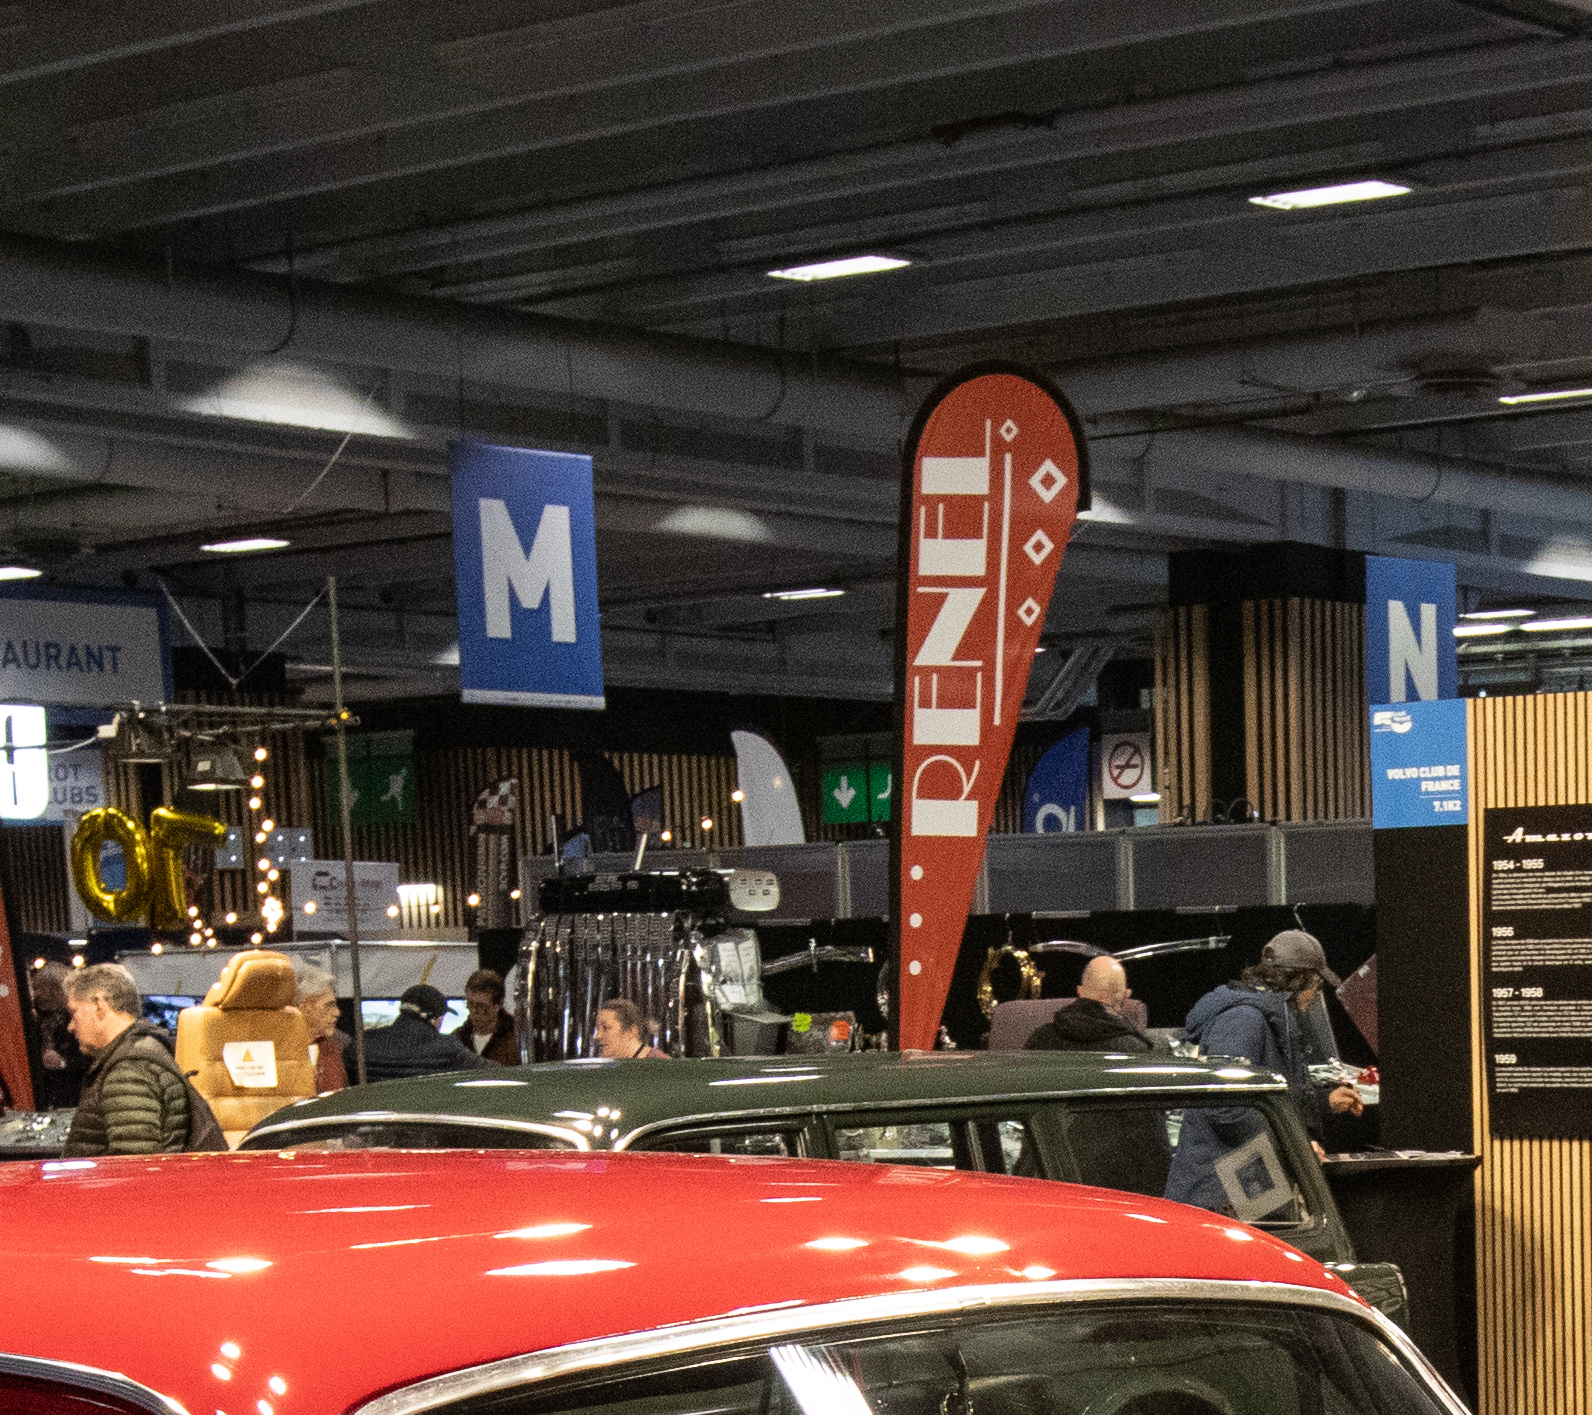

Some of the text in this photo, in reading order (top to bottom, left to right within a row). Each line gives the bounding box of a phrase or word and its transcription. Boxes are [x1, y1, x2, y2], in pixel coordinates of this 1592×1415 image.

[479, 497, 577, 644] M
[911, 418, 992, 837] RENEL
[1387, 600, 1438, 703] N
[1419, 765, 1445, 778] CLUB
[1446, 765, 1461, 776] DE
[1420, 779, 1461, 792] FRANCE
